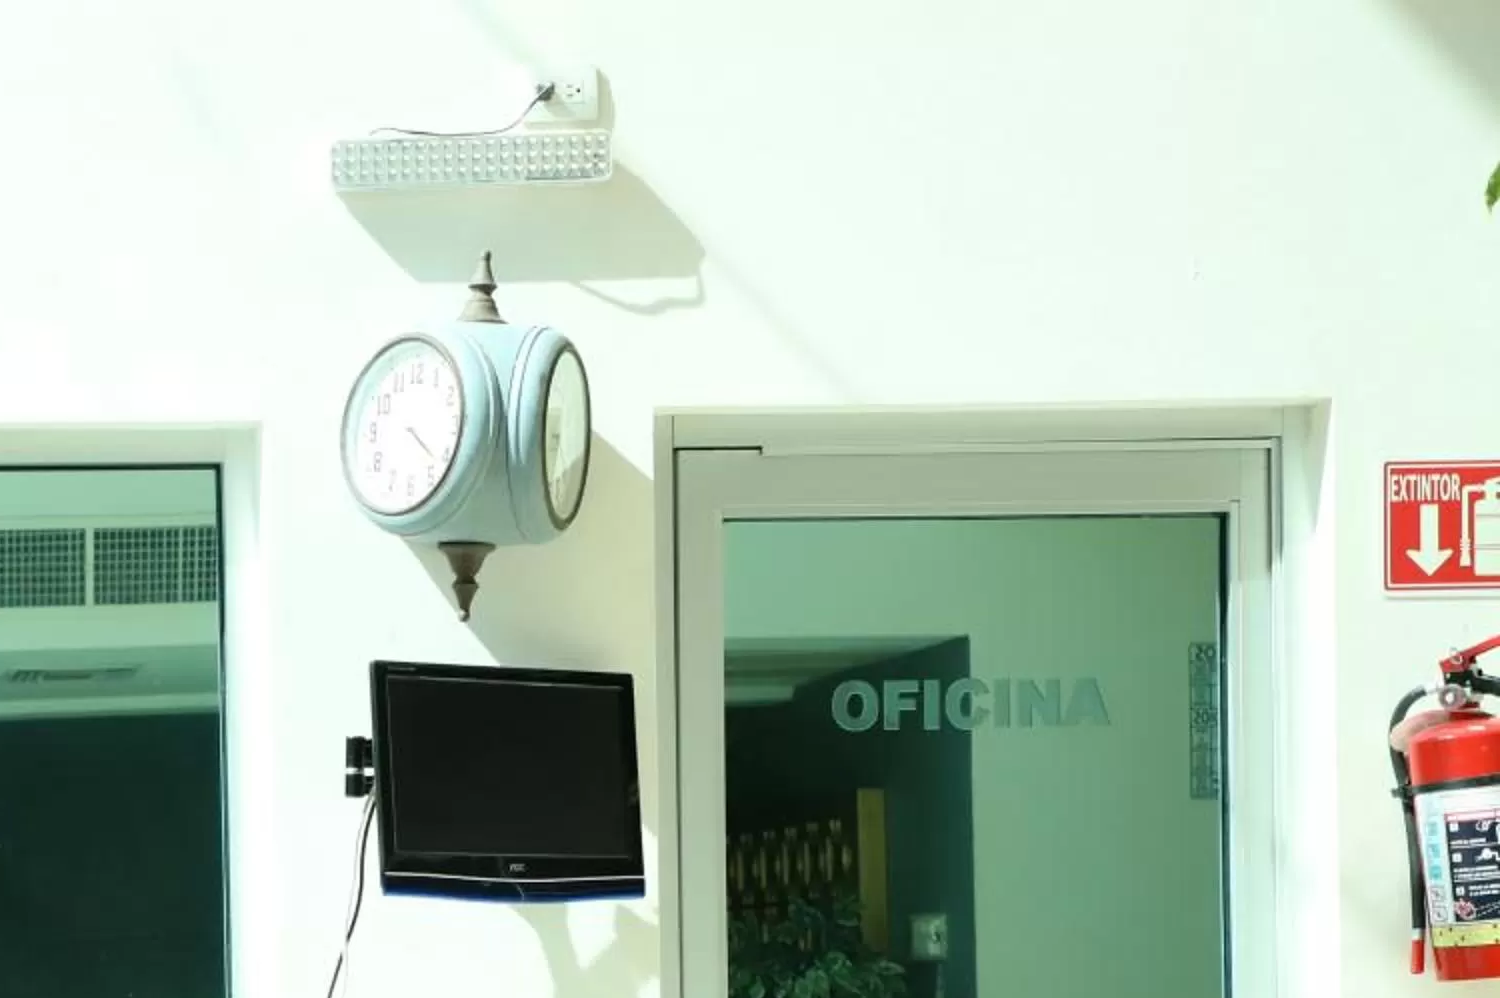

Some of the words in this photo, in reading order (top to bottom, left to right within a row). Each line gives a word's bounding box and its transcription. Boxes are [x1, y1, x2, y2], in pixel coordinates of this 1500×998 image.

[393, 371, 405, 393] 11
[410, 363, 424, 385] 12
[377, 393, 391, 417] 10
[445, 386, 455, 407] 2
[369, 421, 377, 444] 9
[373, 450, 383, 473] 8
[427, 464, 435, 488] 5
[1390, 472, 1461, 503] EXTINTOR
[831, 676, 1112, 732] OFICINA
